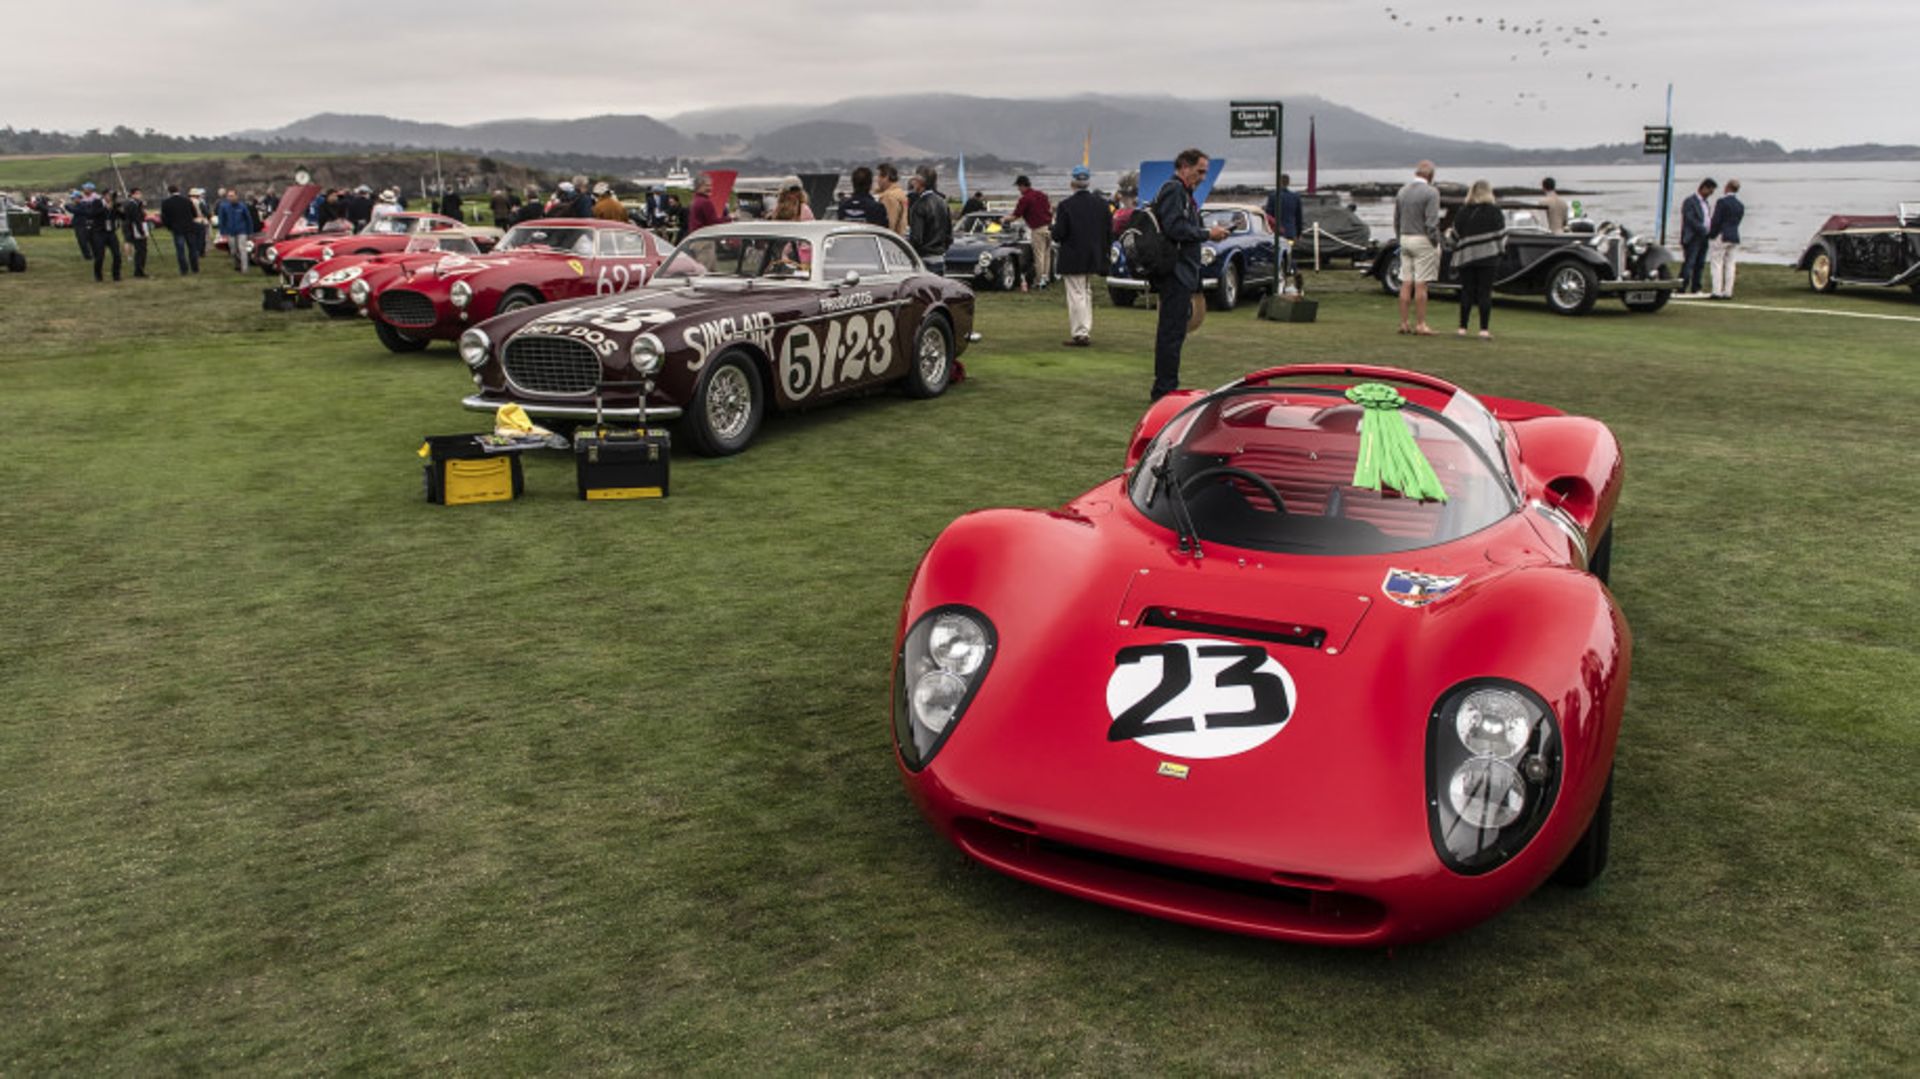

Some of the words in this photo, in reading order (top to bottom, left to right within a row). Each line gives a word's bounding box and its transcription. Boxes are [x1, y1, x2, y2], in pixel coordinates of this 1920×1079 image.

[597, 264, 652, 297] 627
[569, 326, 620, 357] DOS
[682, 311, 775, 371] SINCLAIR
[789, 333, 812, 394] 5
[1107, 643, 1290, 742] 23
